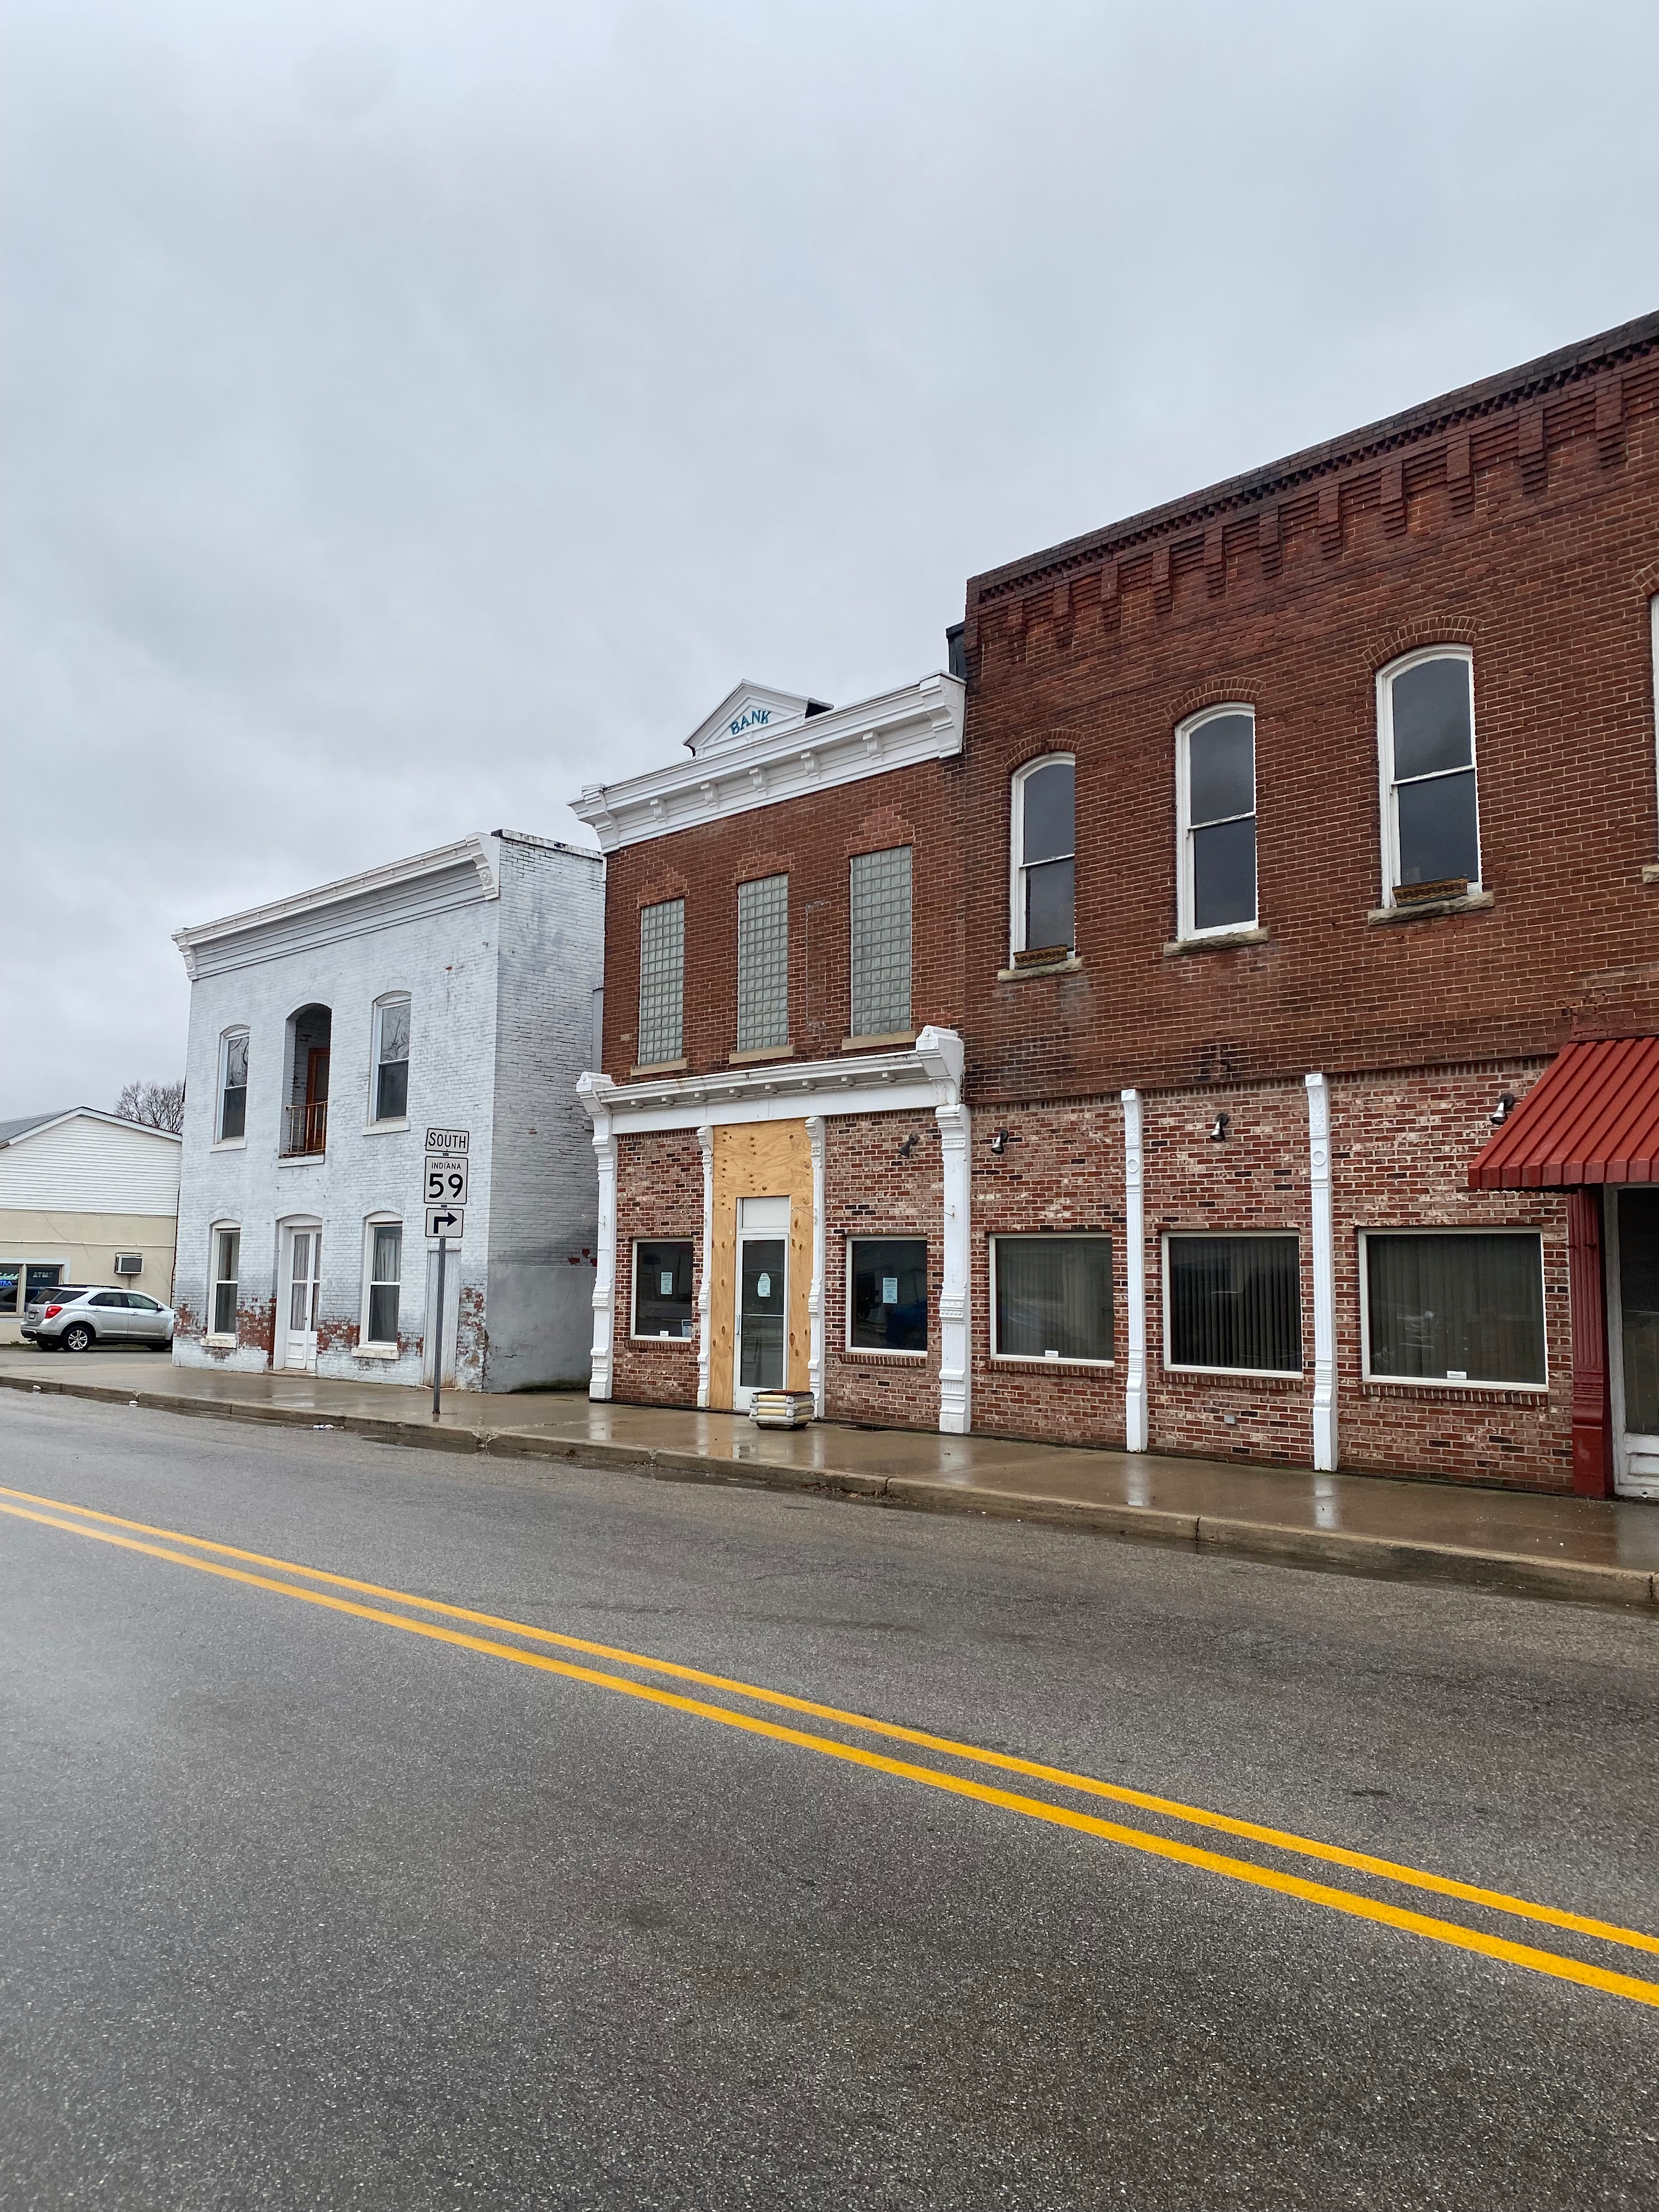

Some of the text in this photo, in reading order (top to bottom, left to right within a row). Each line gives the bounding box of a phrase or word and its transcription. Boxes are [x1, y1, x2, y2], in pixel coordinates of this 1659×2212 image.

[730, 710, 771, 735] BANK
[428, 1132, 466, 1148] SOUTH
[428, 1173, 463, 1198] 59
